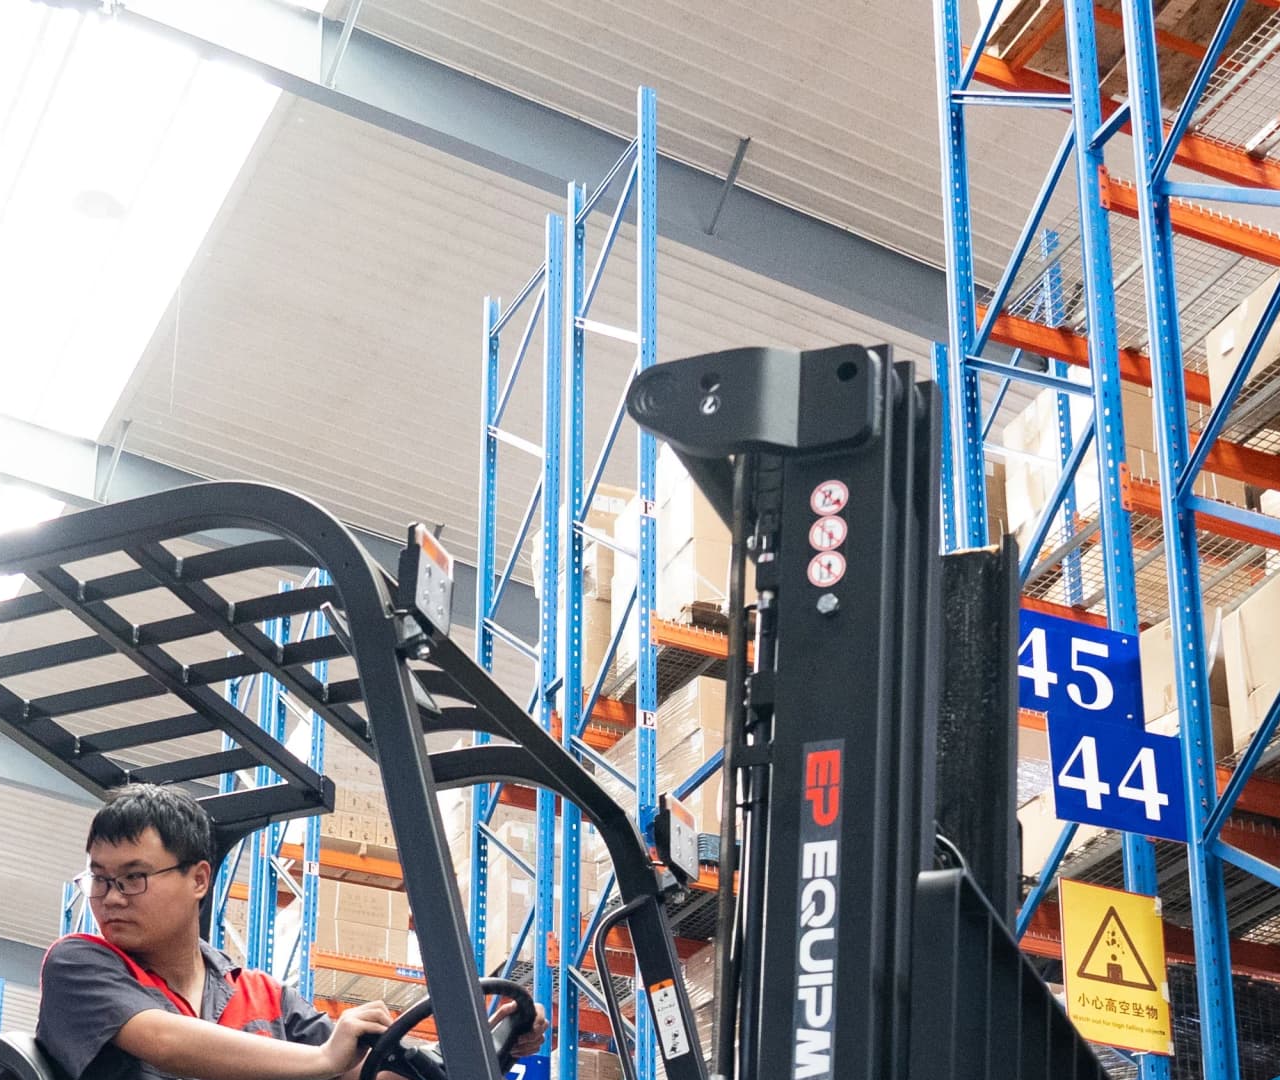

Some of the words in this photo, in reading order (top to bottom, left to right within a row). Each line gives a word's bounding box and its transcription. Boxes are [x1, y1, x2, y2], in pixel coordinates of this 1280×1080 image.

[1018, 627, 1114, 711] 45
[643, 712, 655, 727] E
[806, 750, 841, 826] EP
[1058, 735, 1169, 821] 44
[1078, 993, 1158, 1020] 小心高空坠物
